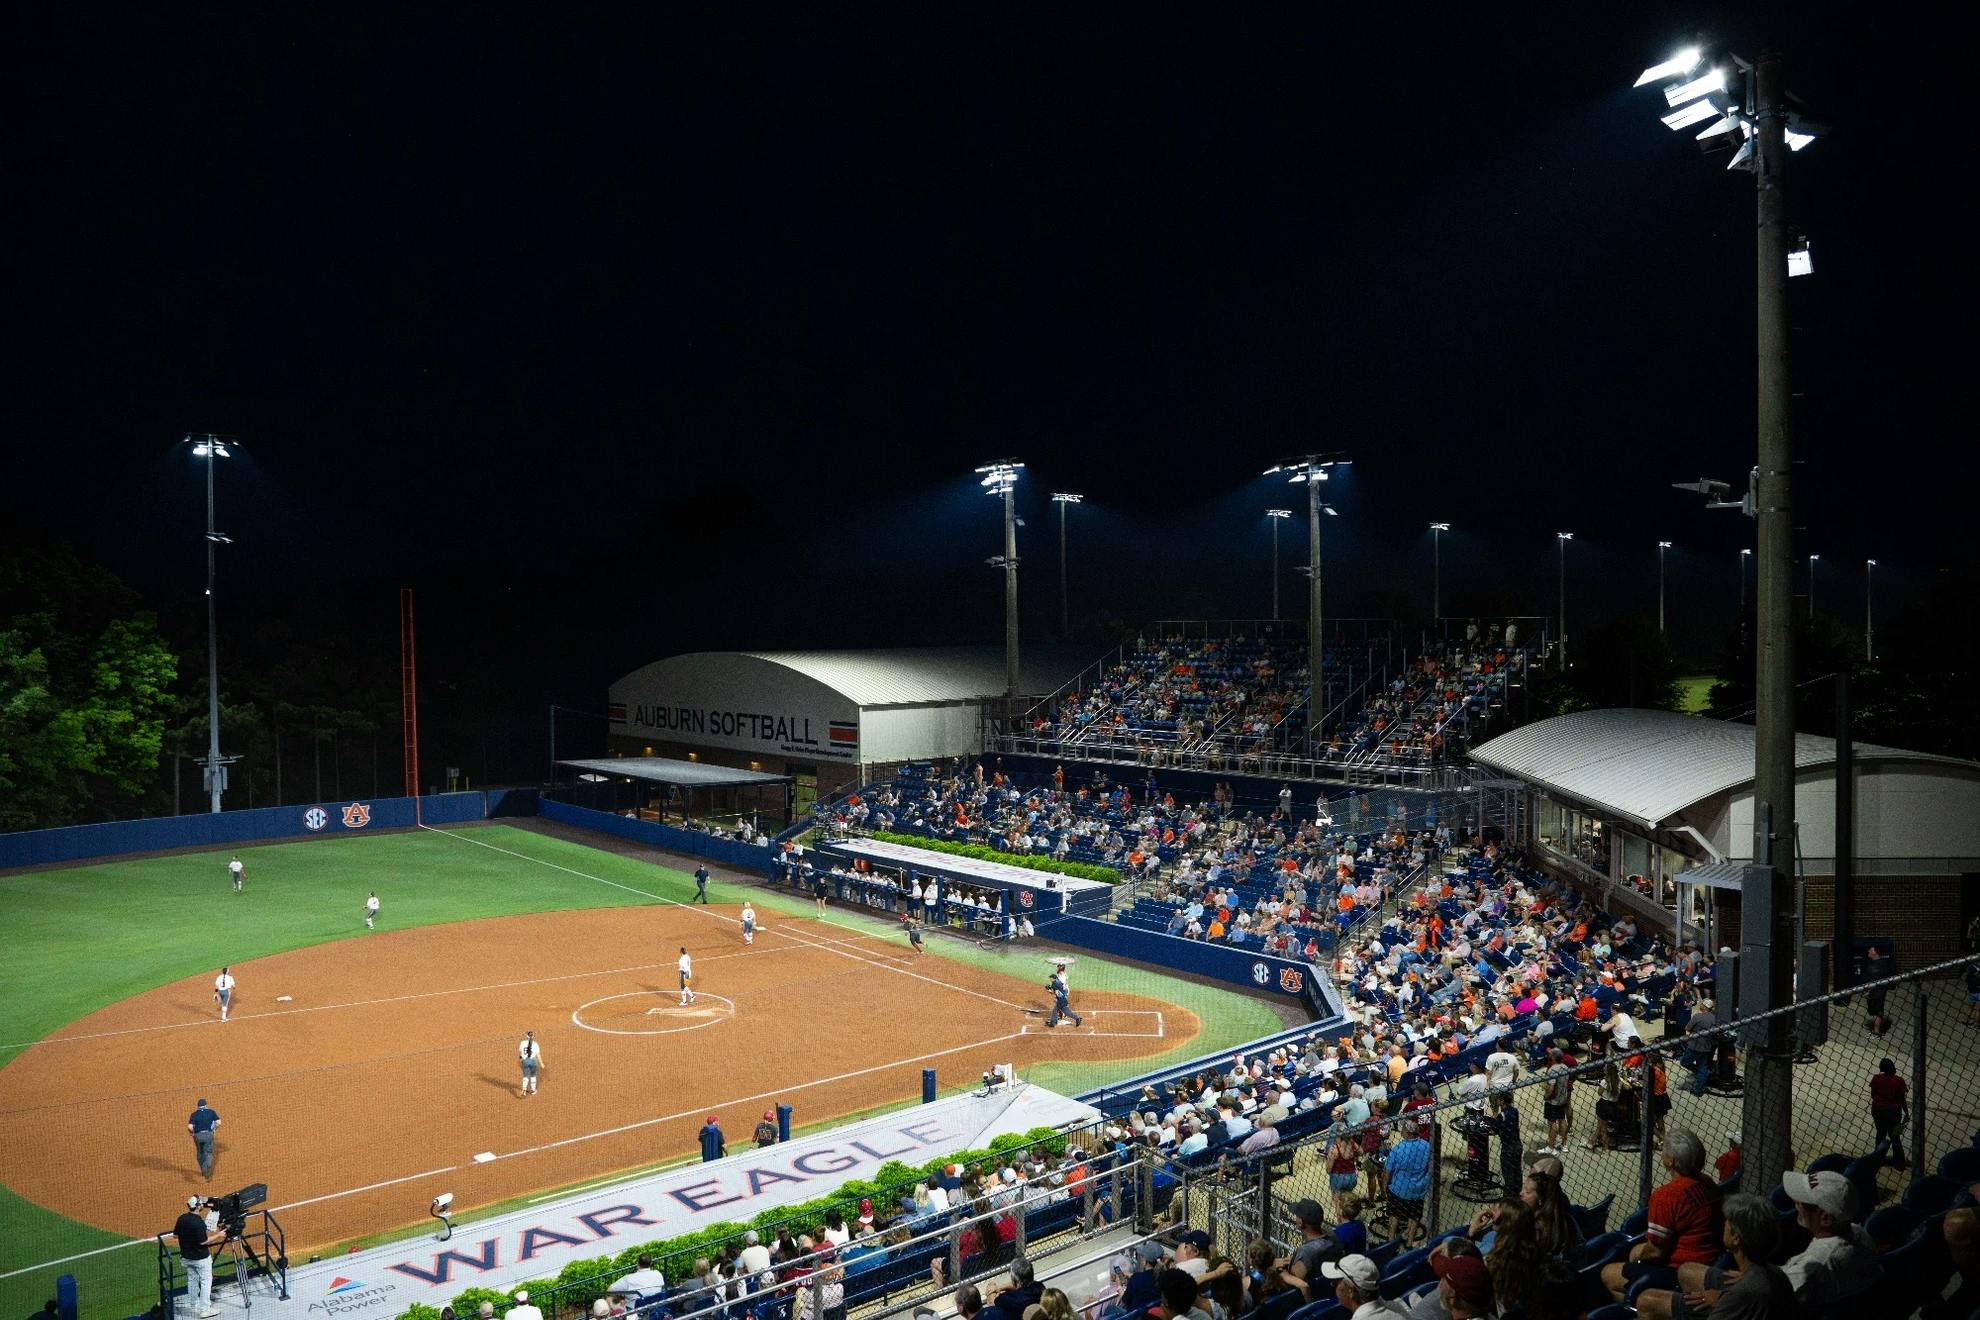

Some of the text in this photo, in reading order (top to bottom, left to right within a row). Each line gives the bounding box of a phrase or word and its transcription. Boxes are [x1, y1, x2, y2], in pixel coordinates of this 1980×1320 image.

[635, 704, 819, 746] AUBURN SOFTBALL
[304, 807, 327, 830] SEC
[383, 1119, 967, 1287] WAR EAGLE
[307, 1284, 397, 1313] Alabama
[325, 1295, 388, 1317] Power
